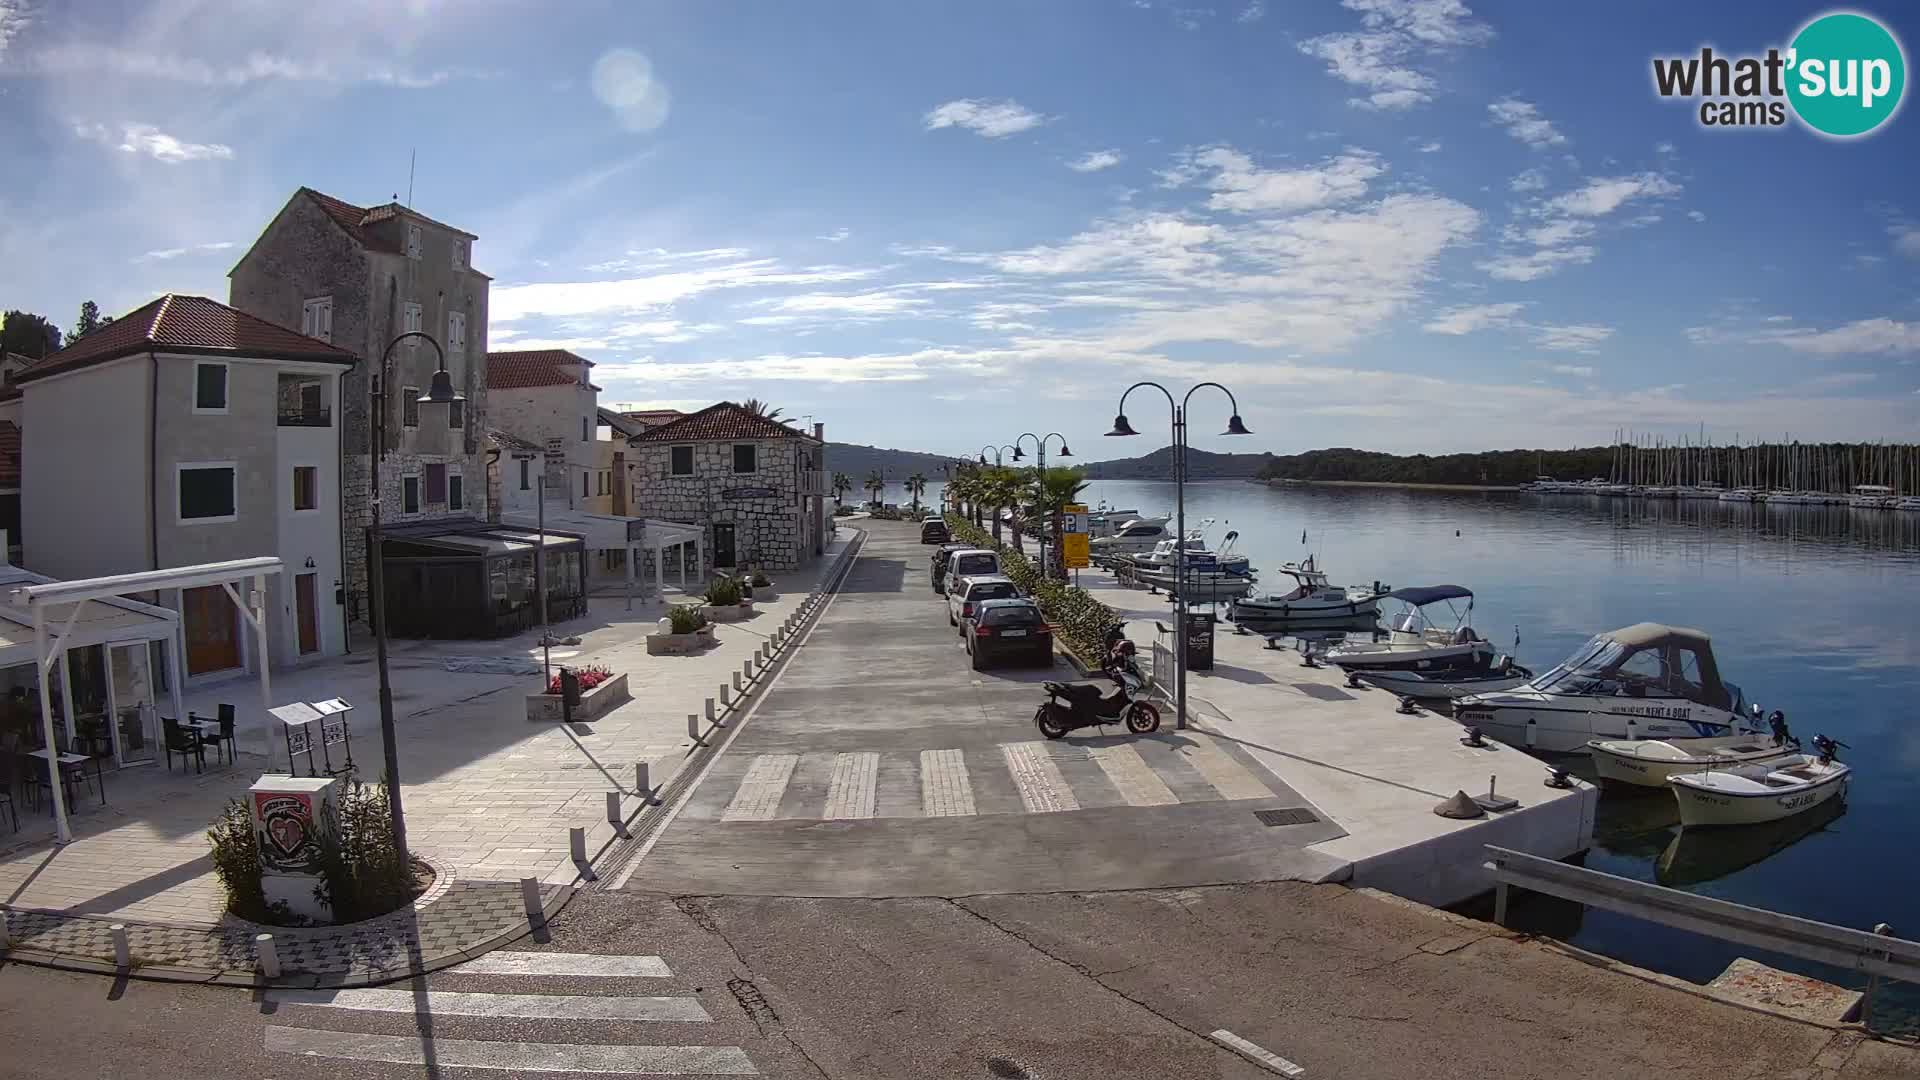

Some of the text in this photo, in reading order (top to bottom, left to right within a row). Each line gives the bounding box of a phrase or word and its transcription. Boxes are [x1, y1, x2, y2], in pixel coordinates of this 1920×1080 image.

[1065, 515, 1076, 532] P
[1646, 706, 1666, 718] RENT
[1665, 707, 1671, 717] A
[1672, 707, 1691, 720] BOAT
